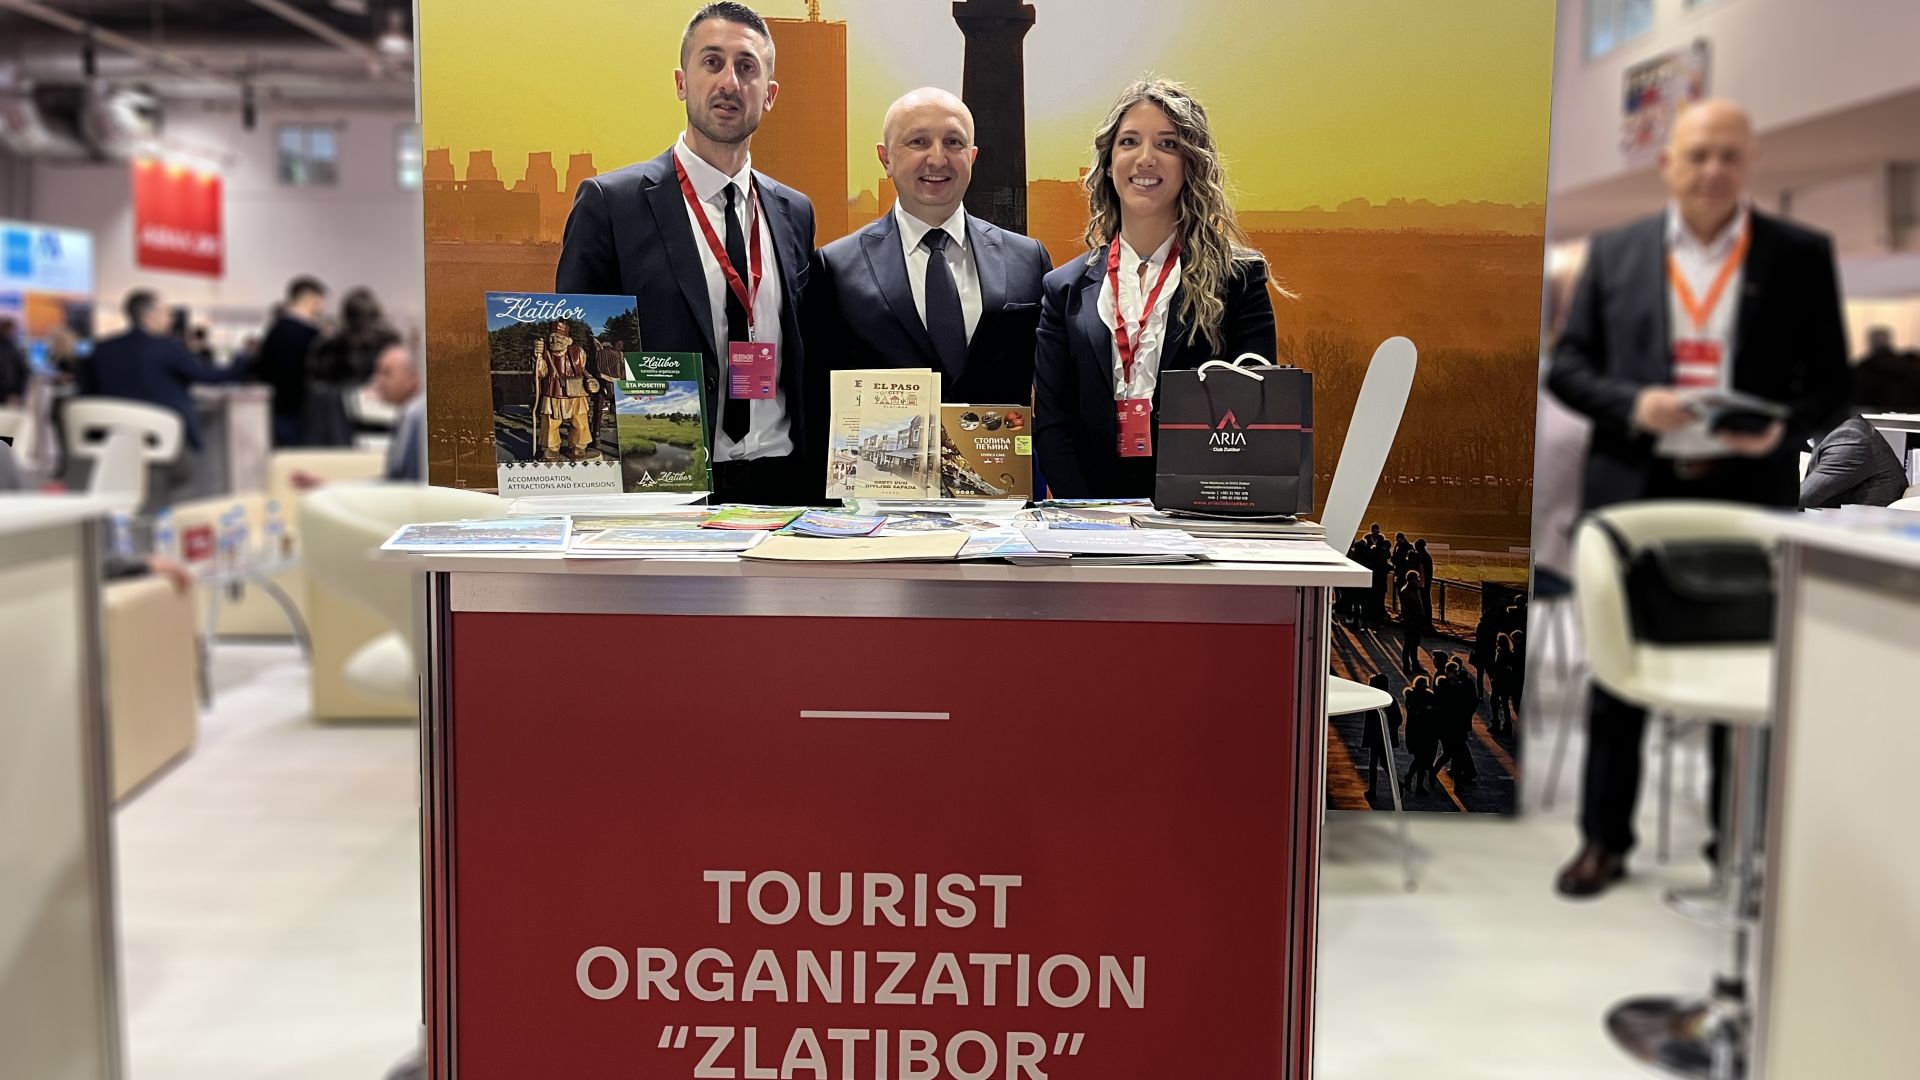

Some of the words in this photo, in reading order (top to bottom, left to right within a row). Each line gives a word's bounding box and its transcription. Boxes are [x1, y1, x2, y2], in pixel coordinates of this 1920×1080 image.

[496, 297, 586, 323] Zlatibor
[638, 356, 680, 370] Zlatibor
[873, 382, 888, 390] EL
[890, 383, 920, 391] PASO
[973, 437, 1011, 445] СТОПИЋА
[1209, 432, 1247, 446] ARIA
[657, 471, 693, 483] Zlatibor
[508, 482, 555, 490] ATTRACTIONS
[573, 481, 616, 489] EXCURSIONS
[703, 869, 1023, 929] TOURIST
[575, 946, 1146, 1009] ORGANIZATION
[657, 1024, 1086, 1080] “ZLATIBOR”
